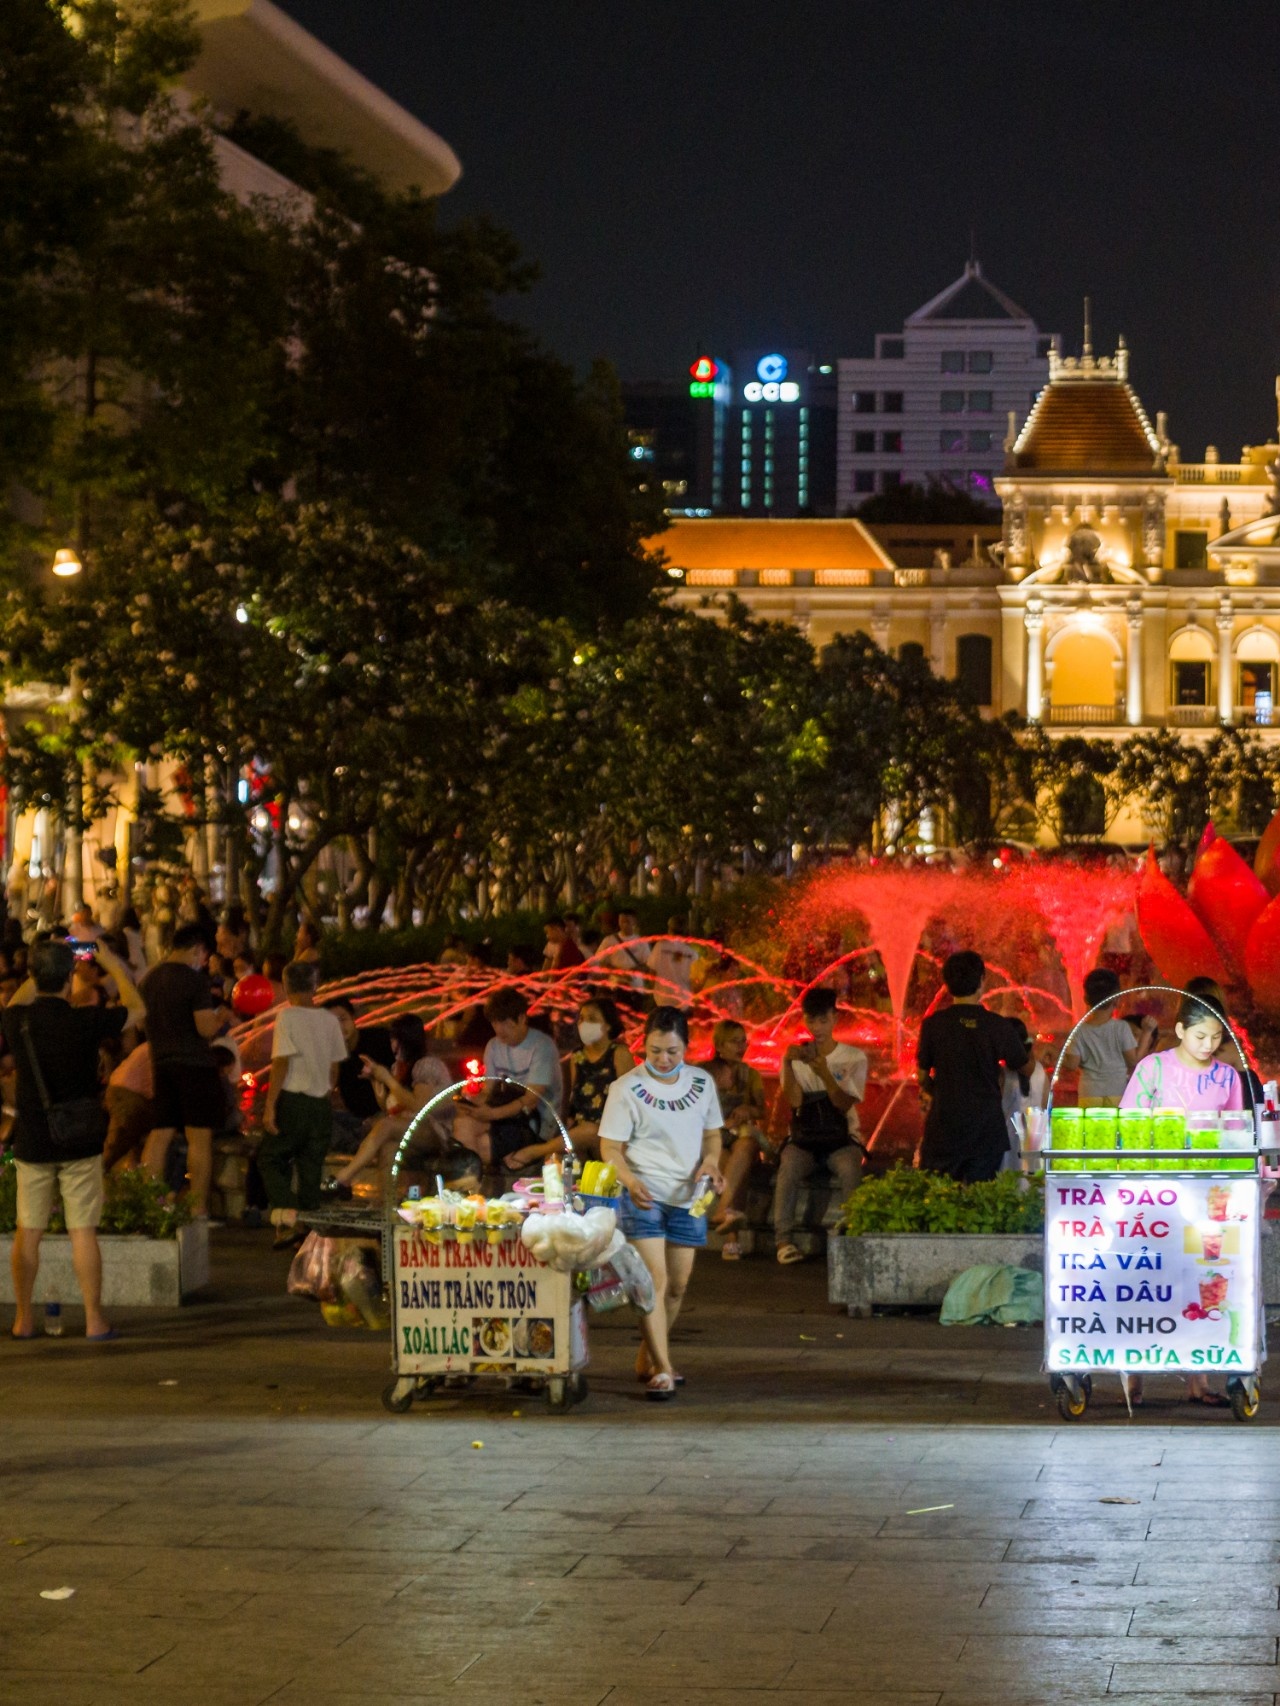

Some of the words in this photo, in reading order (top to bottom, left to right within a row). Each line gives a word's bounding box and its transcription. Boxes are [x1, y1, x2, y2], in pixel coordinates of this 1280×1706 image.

[743, 382, 800, 402] CCB
[631, 1083, 666, 1110] LOUIS
[667, 1076, 706, 1112] VUITTON
[1057, 1183, 1106, 1206] TRÀ
[1059, 1215, 1106, 1238] TRÀ
[1116, 1212, 1170, 1238] TẮC
[1117, 1246, 1162, 1270] VẢI
[400, 1272, 441, 1309] BÁNH
[444, 1271, 494, 1309] TRÁNG
[497, 1270, 536, 1315] TRỘN
[1059, 1280, 1106, 1302] TRÀ
[1116, 1280, 1173, 1302] DÂU
[402, 1318, 438, 1355] XOÀI
[441, 1311, 470, 1355] LẮC
[1057, 1313, 1106, 1334] TRÀ
[1116, 1316, 1177, 1334] NHO
[1059, 1344, 1115, 1365] SÂM
[1125, 1344, 1181, 1365] DỨA
[1191, 1344, 1242, 1365] SỮA
